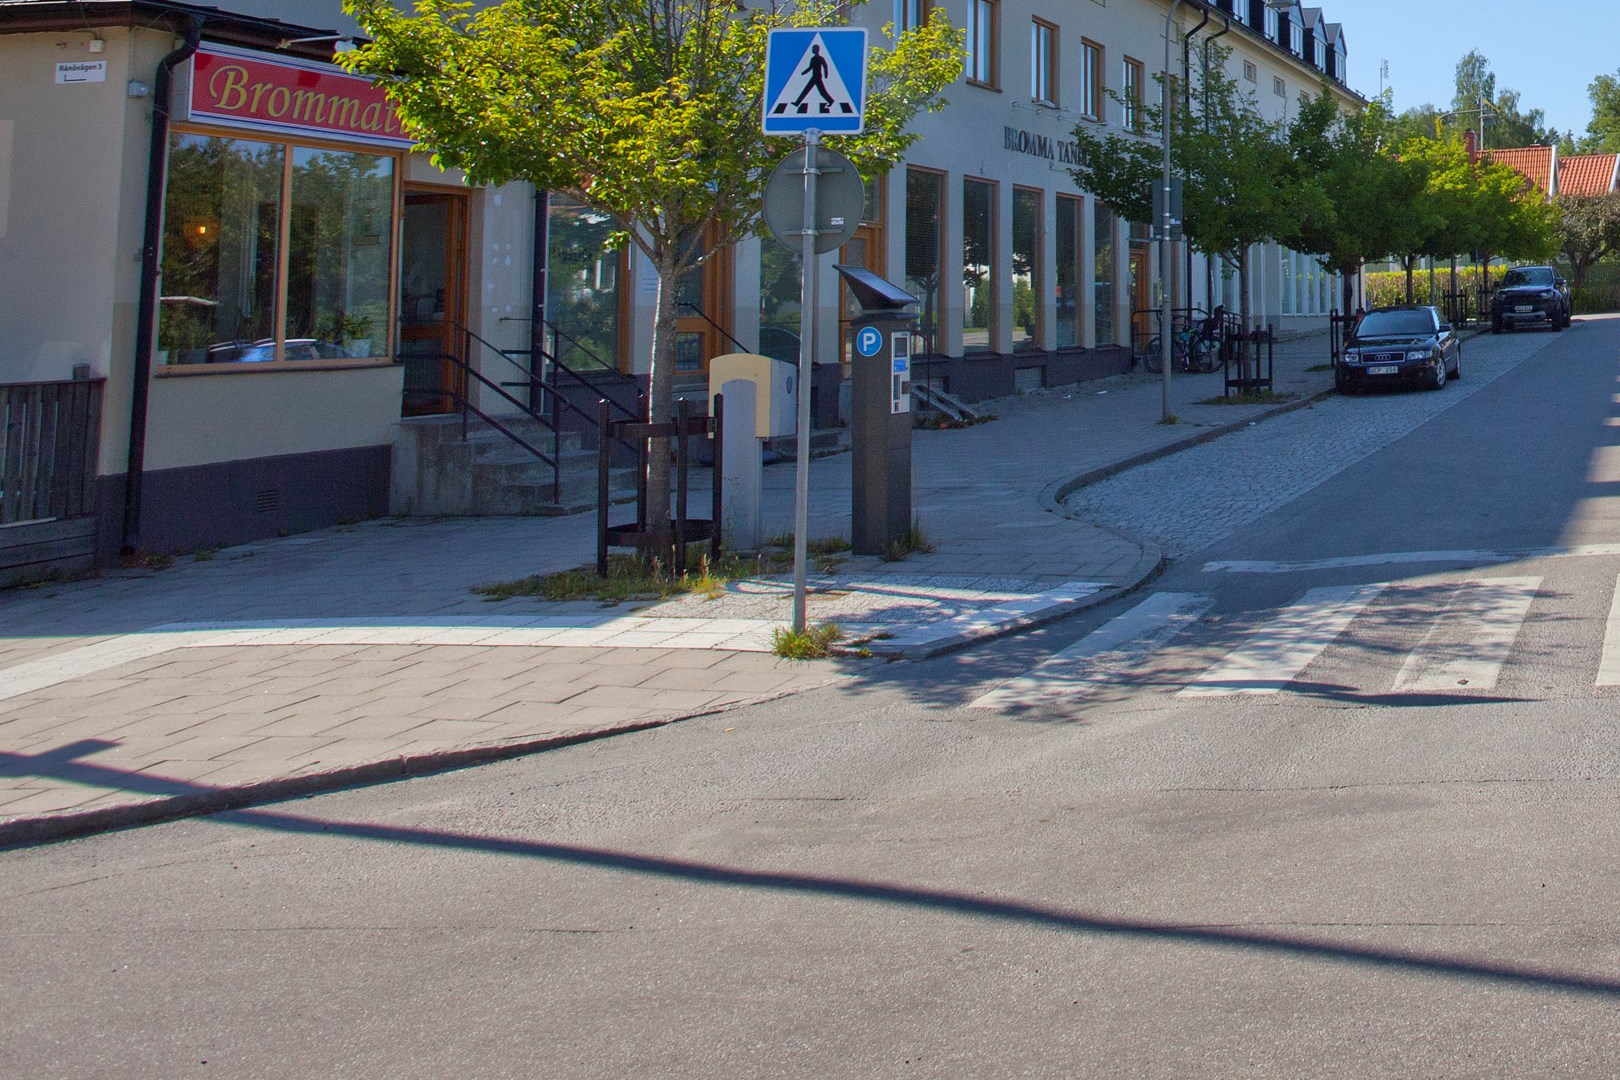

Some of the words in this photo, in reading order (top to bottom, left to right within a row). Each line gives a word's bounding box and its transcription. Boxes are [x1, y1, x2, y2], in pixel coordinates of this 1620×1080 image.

[59, 63, 98, 72] Rånövägen
[1003, 125, 1055, 160] BROMMA
[863, 332, 876, 352] P
